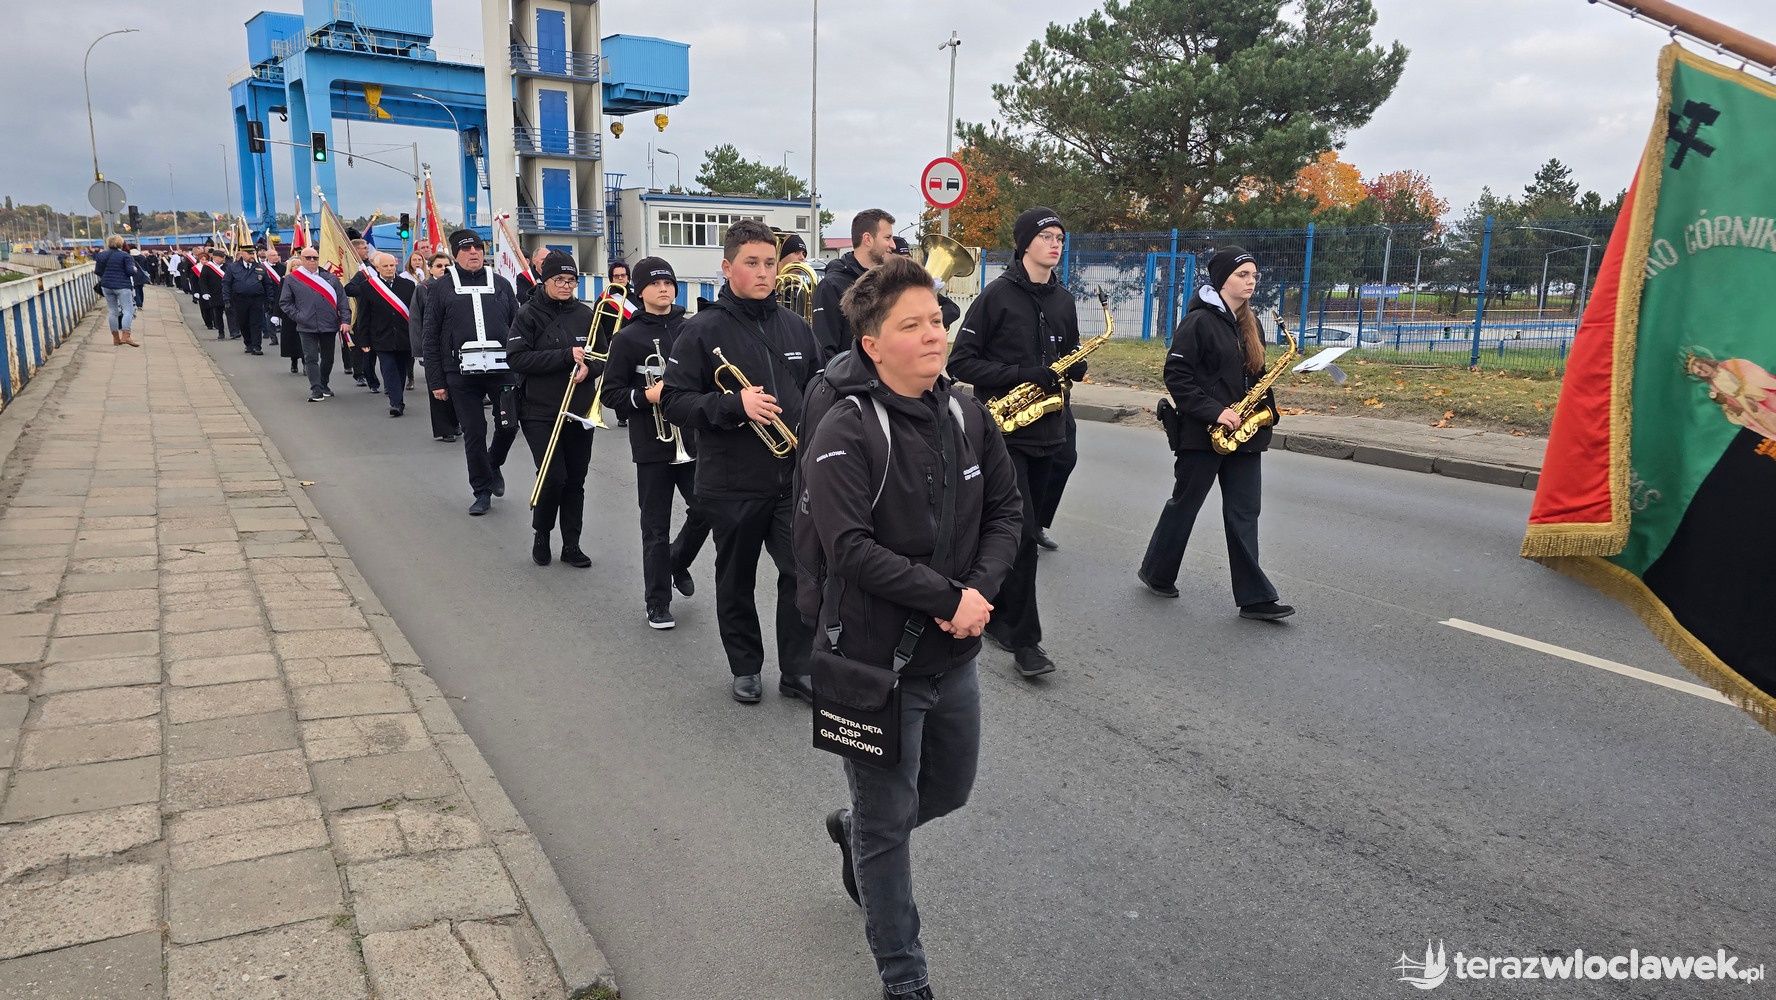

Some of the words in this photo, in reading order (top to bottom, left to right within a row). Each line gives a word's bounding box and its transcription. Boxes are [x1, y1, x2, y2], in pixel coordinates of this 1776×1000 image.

[820, 709, 861, 729] ORKIESTRA
[861, 723, 883, 735] DĘTA
[838, 726, 861, 739] OSP
[820, 728, 883, 756] GRABKOWO
